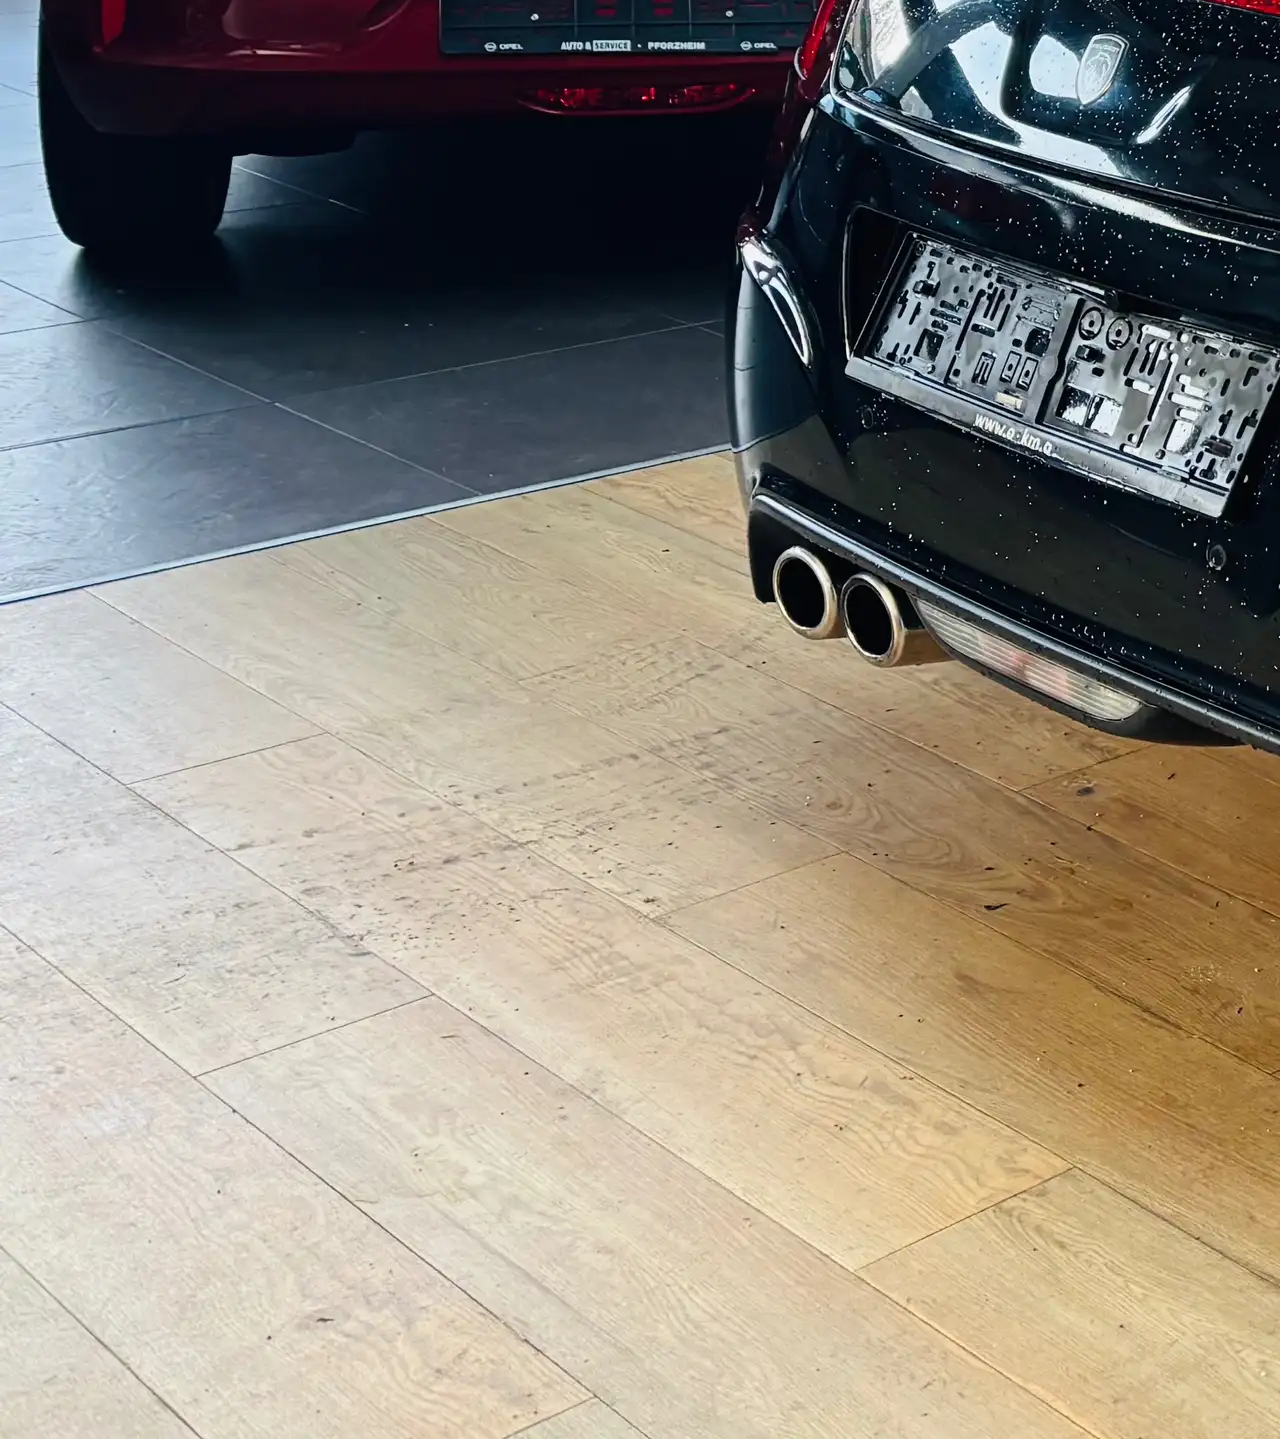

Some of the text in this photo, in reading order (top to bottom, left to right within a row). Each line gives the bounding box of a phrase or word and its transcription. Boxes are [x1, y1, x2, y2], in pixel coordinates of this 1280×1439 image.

[499, 43, 524, 51] OPEL
[561, 41, 584, 51] AUTO
[594, 41, 629, 50] SERVICE
[648, 41, 706, 50] PFORZHEIM
